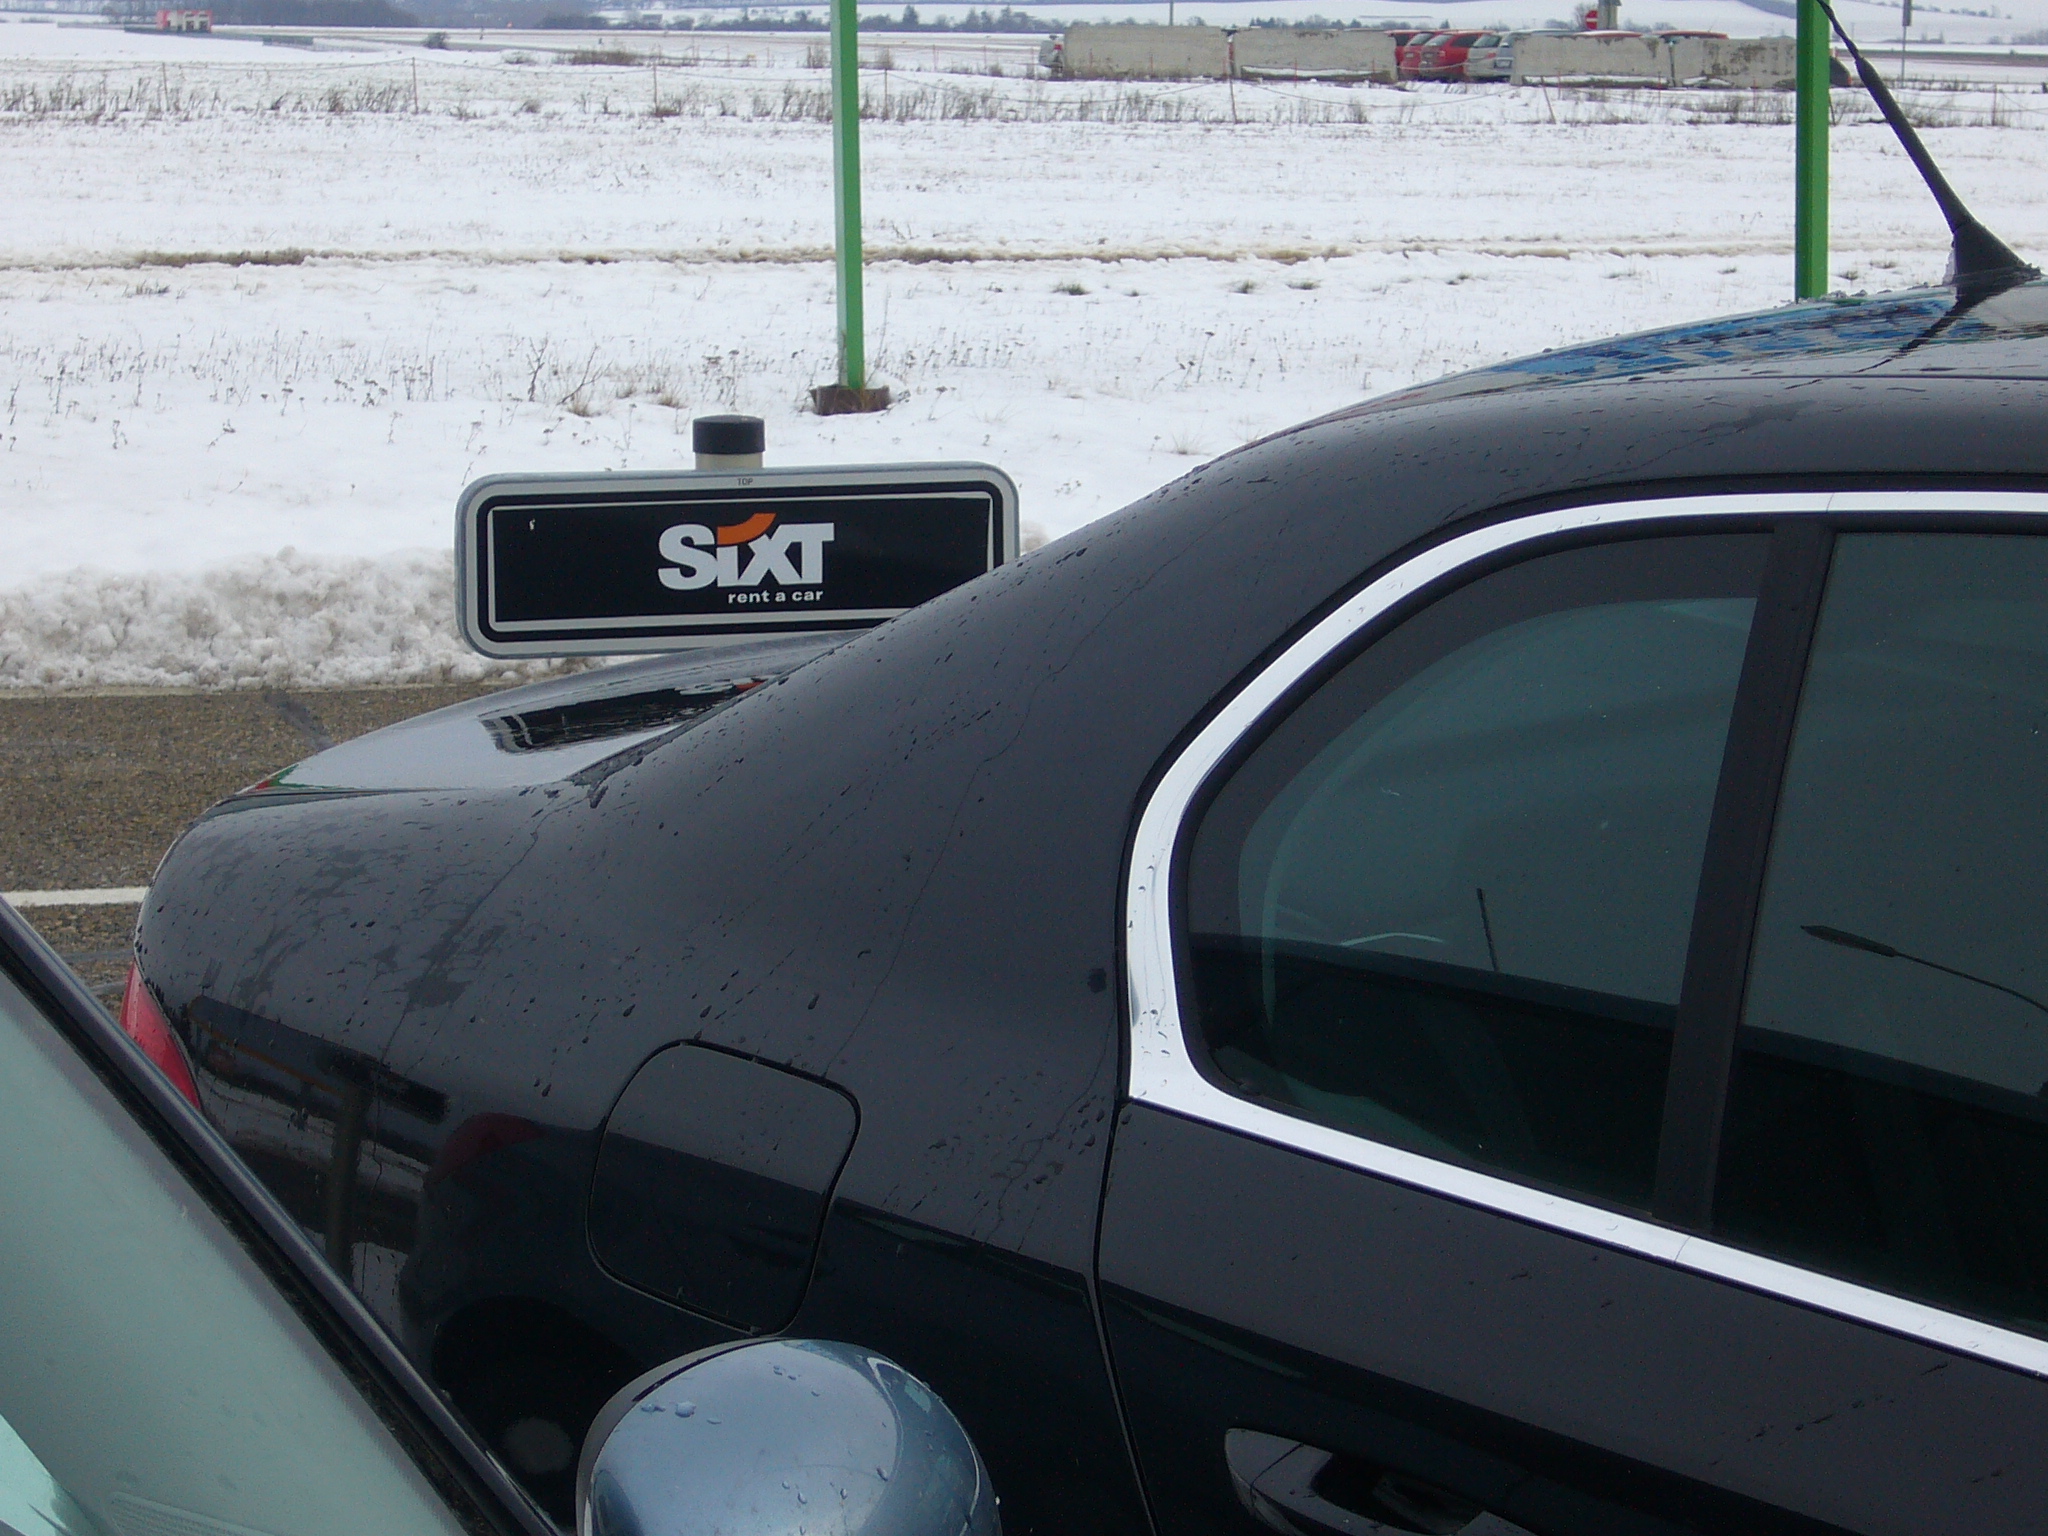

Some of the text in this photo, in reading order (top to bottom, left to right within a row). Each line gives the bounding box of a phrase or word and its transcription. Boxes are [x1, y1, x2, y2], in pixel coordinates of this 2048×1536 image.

[727, 589, 824, 604] rent a car
